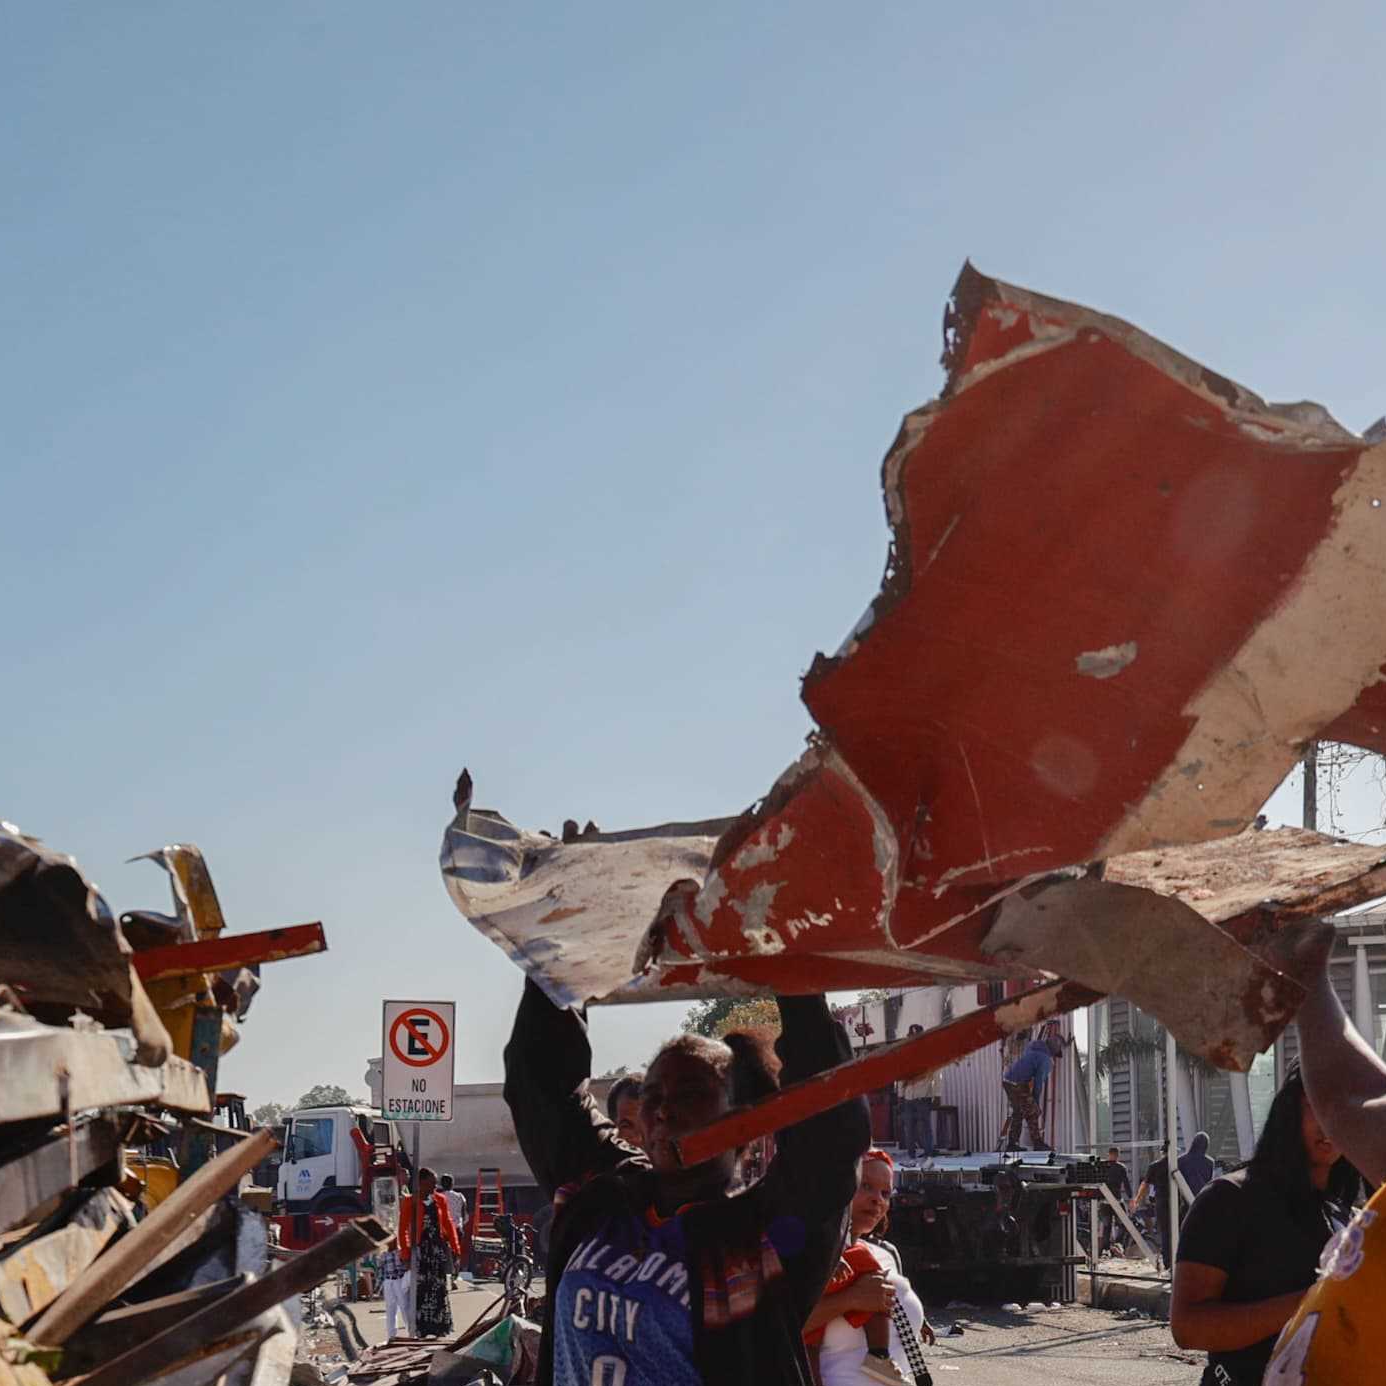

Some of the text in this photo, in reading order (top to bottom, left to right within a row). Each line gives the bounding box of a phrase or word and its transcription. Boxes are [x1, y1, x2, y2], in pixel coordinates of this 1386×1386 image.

[408, 1018, 430, 1055] E
[412, 1078, 427, 1093] NO
[388, 1098, 446, 1114] ESTACIONE
[573, 1287, 639, 1342] CITY
